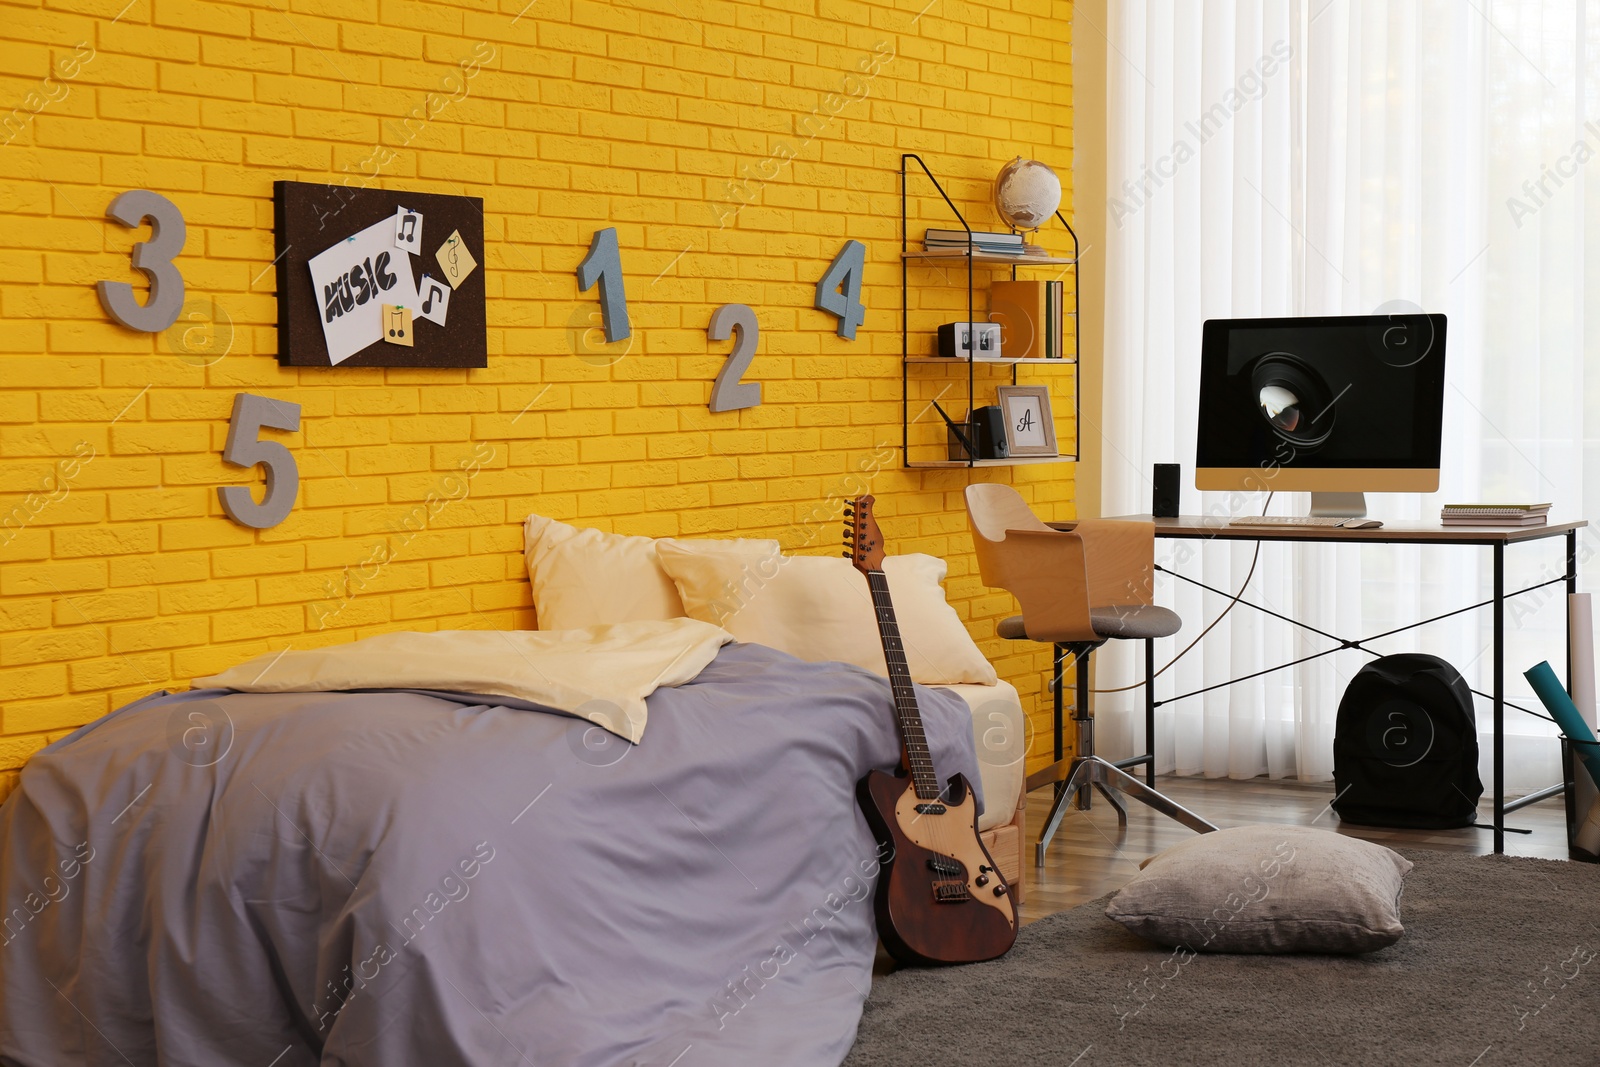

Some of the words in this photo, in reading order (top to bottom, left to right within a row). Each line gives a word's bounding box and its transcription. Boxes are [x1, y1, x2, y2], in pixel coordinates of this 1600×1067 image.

[97, 189, 186, 333] 3
[324, 251, 398, 324] MUSIC
[577, 227, 630, 343] 1
[815, 240, 865, 341] 4
[708, 303, 761, 413] 2
[217, 392, 301, 530] 5
[1016, 408, 1036, 432] A
